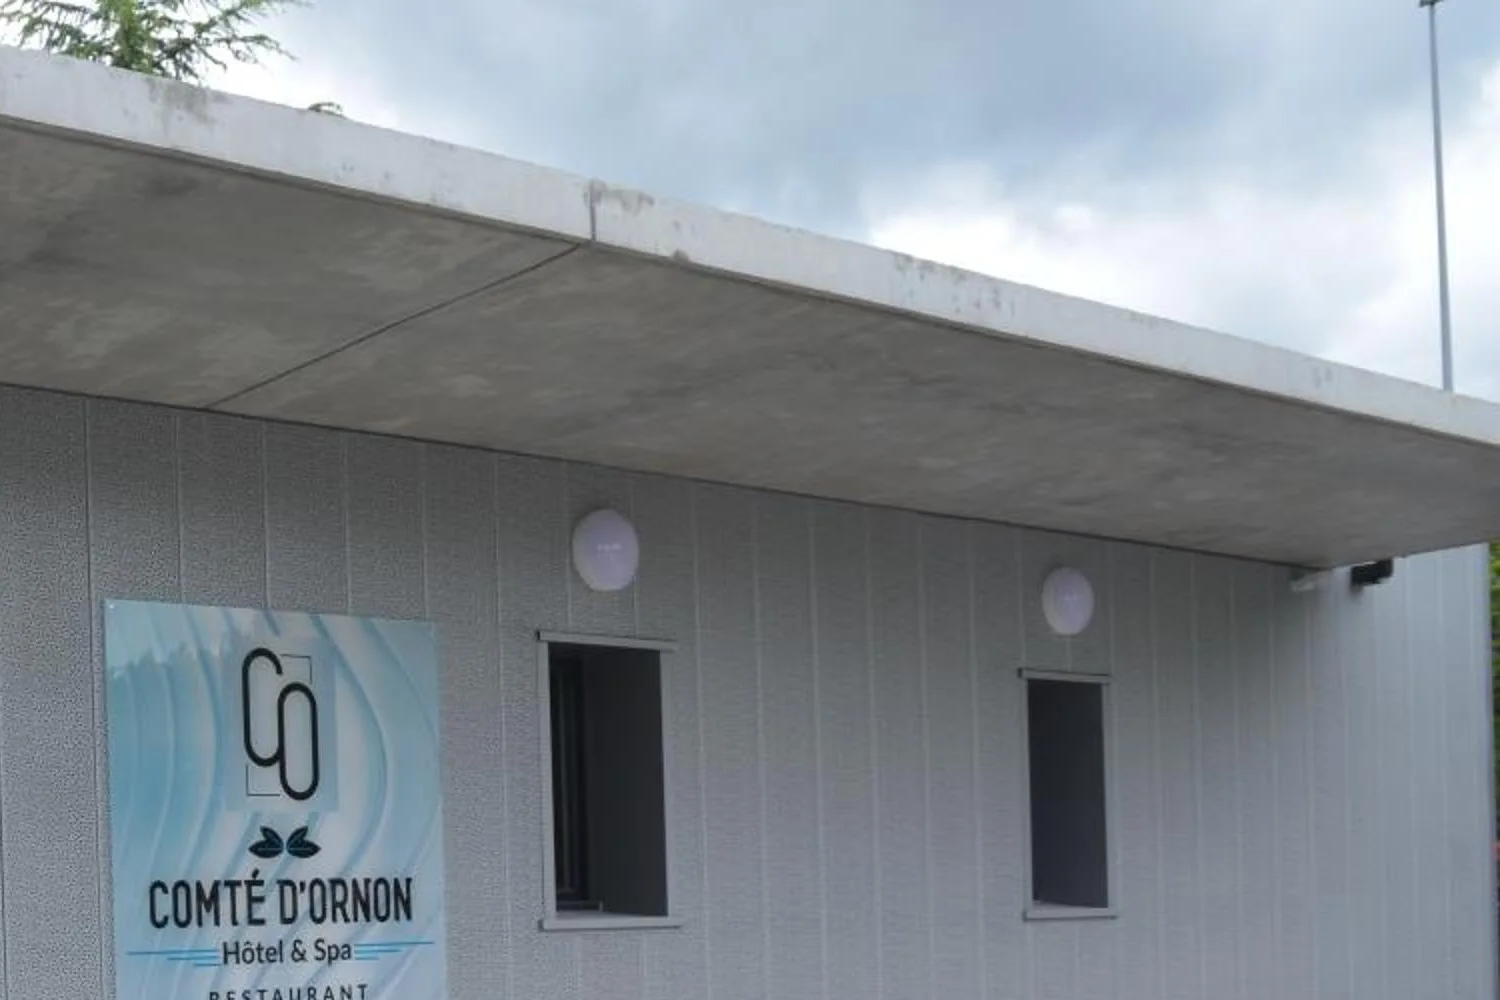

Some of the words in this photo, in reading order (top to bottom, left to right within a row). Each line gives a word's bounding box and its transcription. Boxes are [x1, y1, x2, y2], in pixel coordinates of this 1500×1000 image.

[149, 869, 266, 929] COMTÉ
[277, 877, 414, 924] D'ORNON
[223, 939, 283, 965] Hôtel
[291, 940, 307, 964] &
[315, 938, 353, 966] Spa
